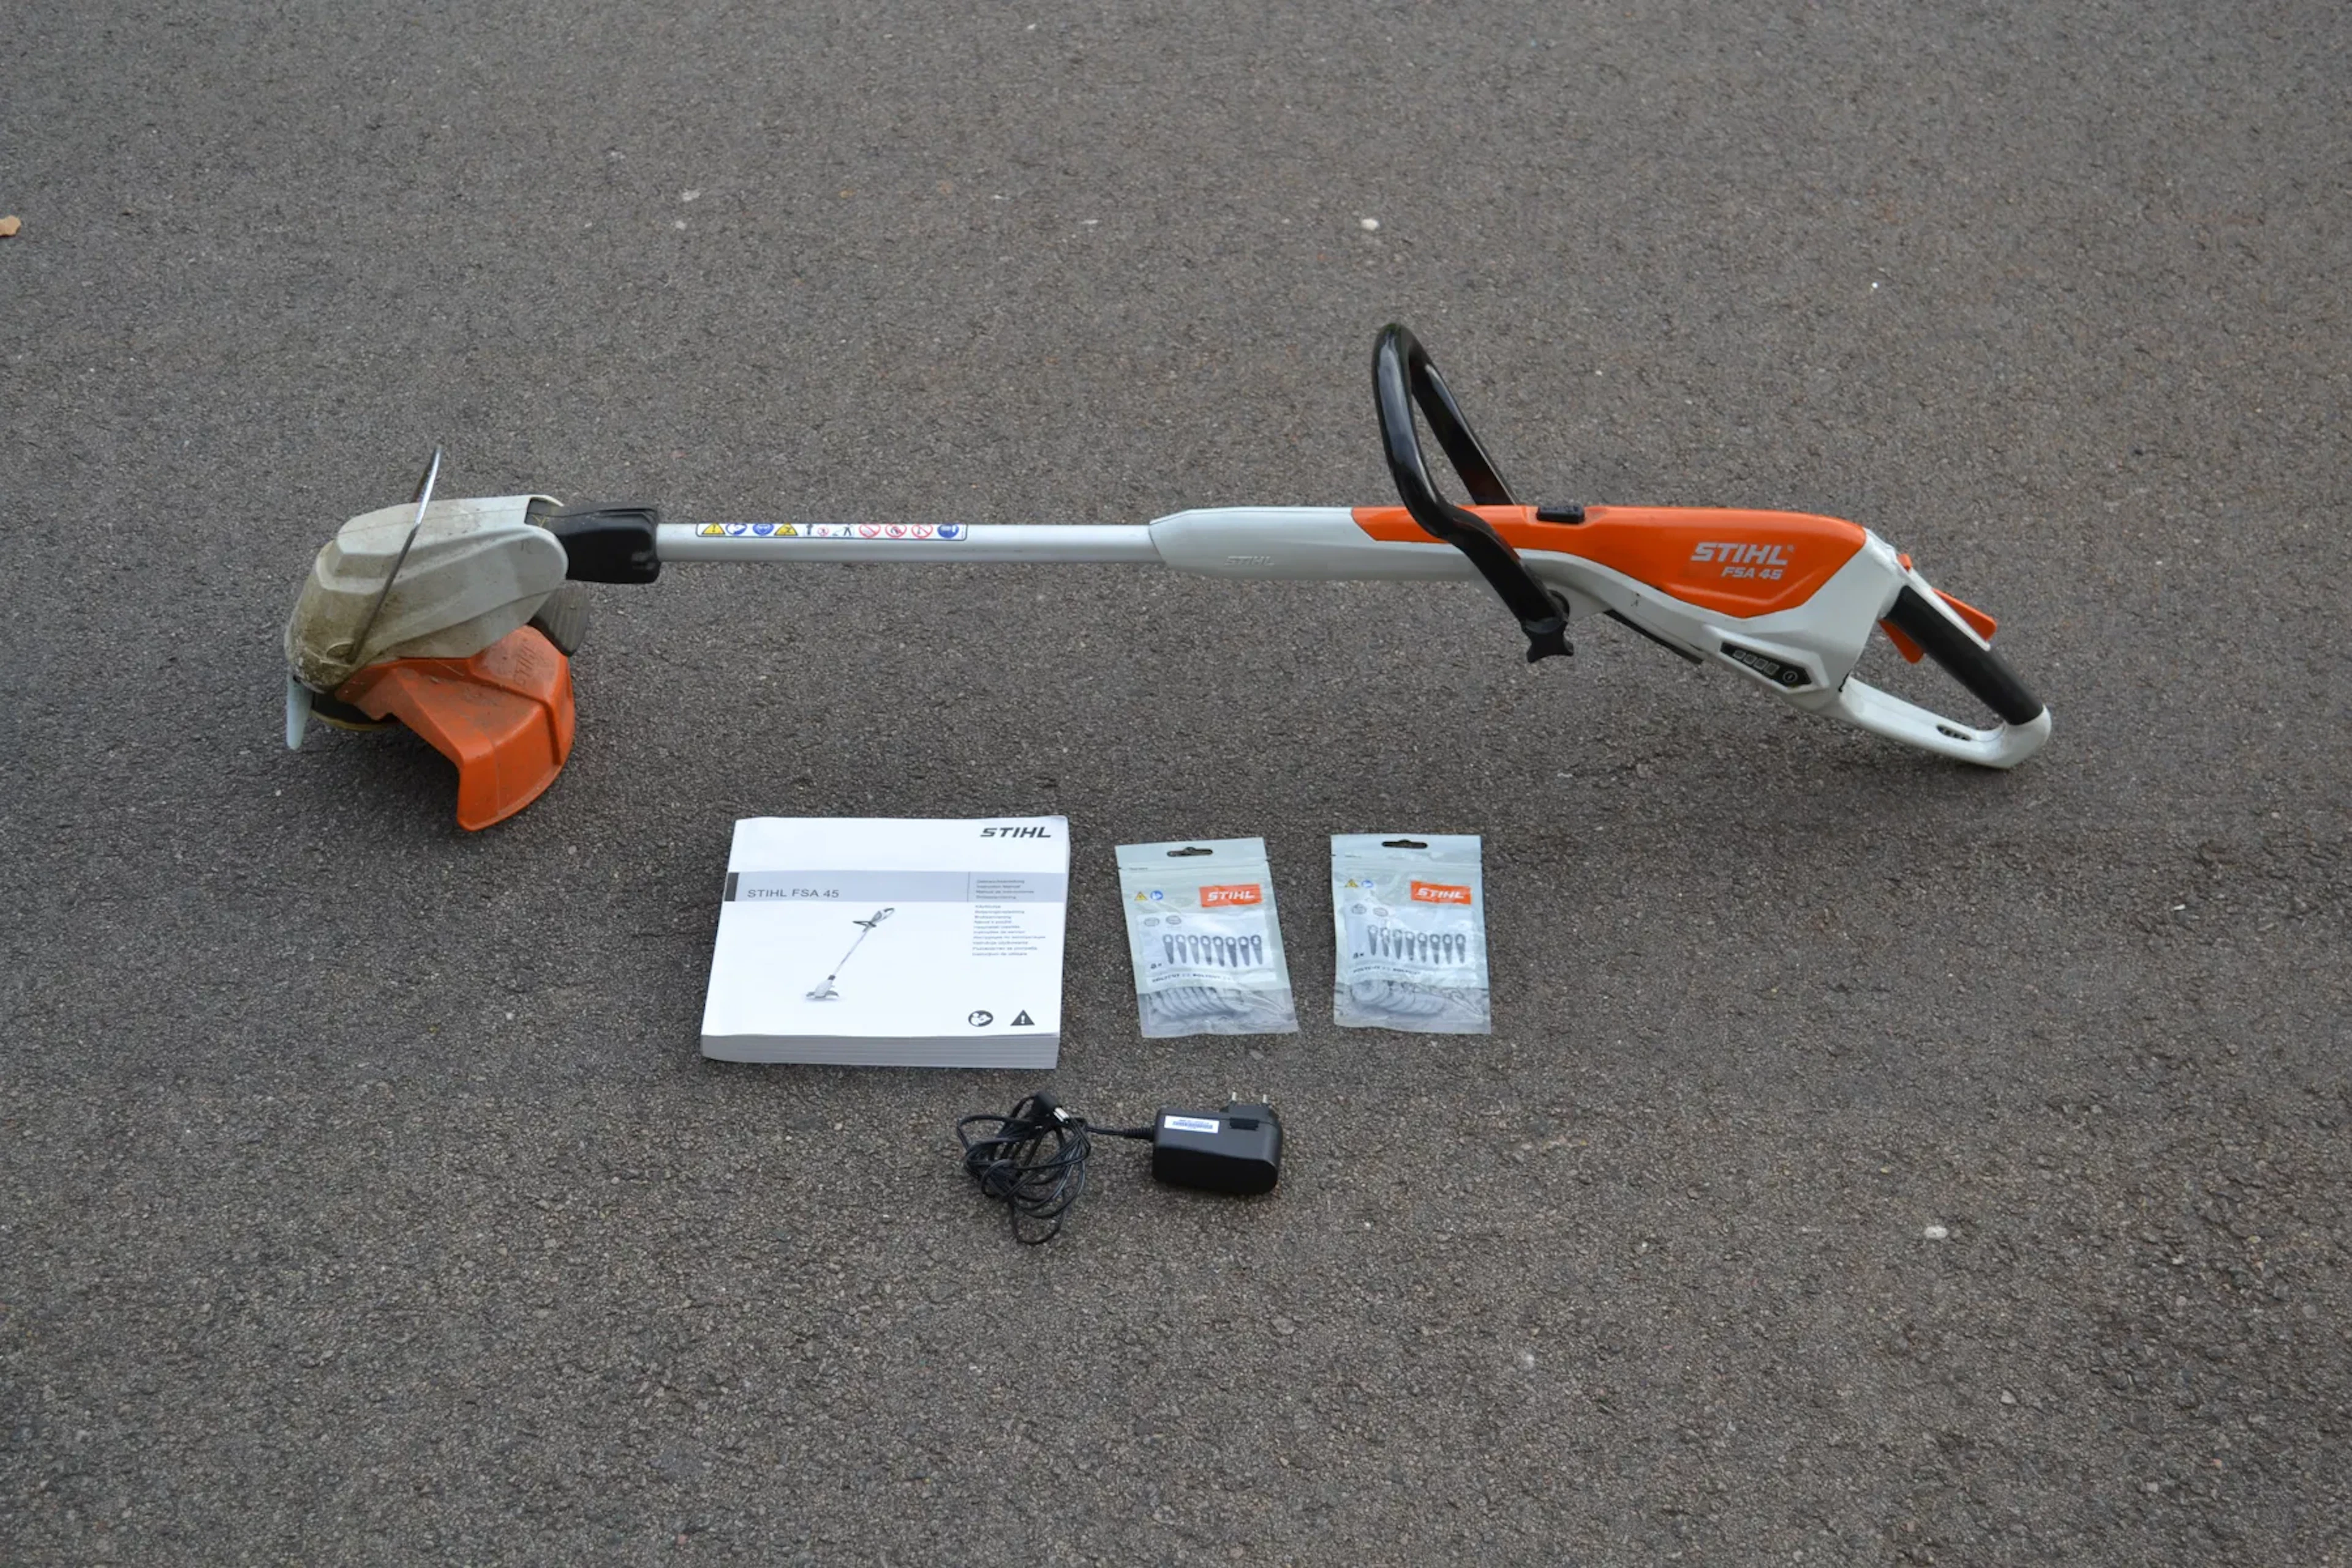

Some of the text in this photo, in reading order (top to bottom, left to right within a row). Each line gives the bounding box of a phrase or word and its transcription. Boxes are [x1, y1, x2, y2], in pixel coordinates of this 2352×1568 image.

[1690, 541, 1789, 565] STIHL
[1224, 555, 1276, 567] STIHL
[1721, 566, 1784, 581] FSA 45
[979, 826, 1052, 839] STIHL
[747, 888, 840, 899] STIHL FSA 45
[1207, 889, 1256, 902] STIHL
[1415, 887, 1465, 900] STIHL
